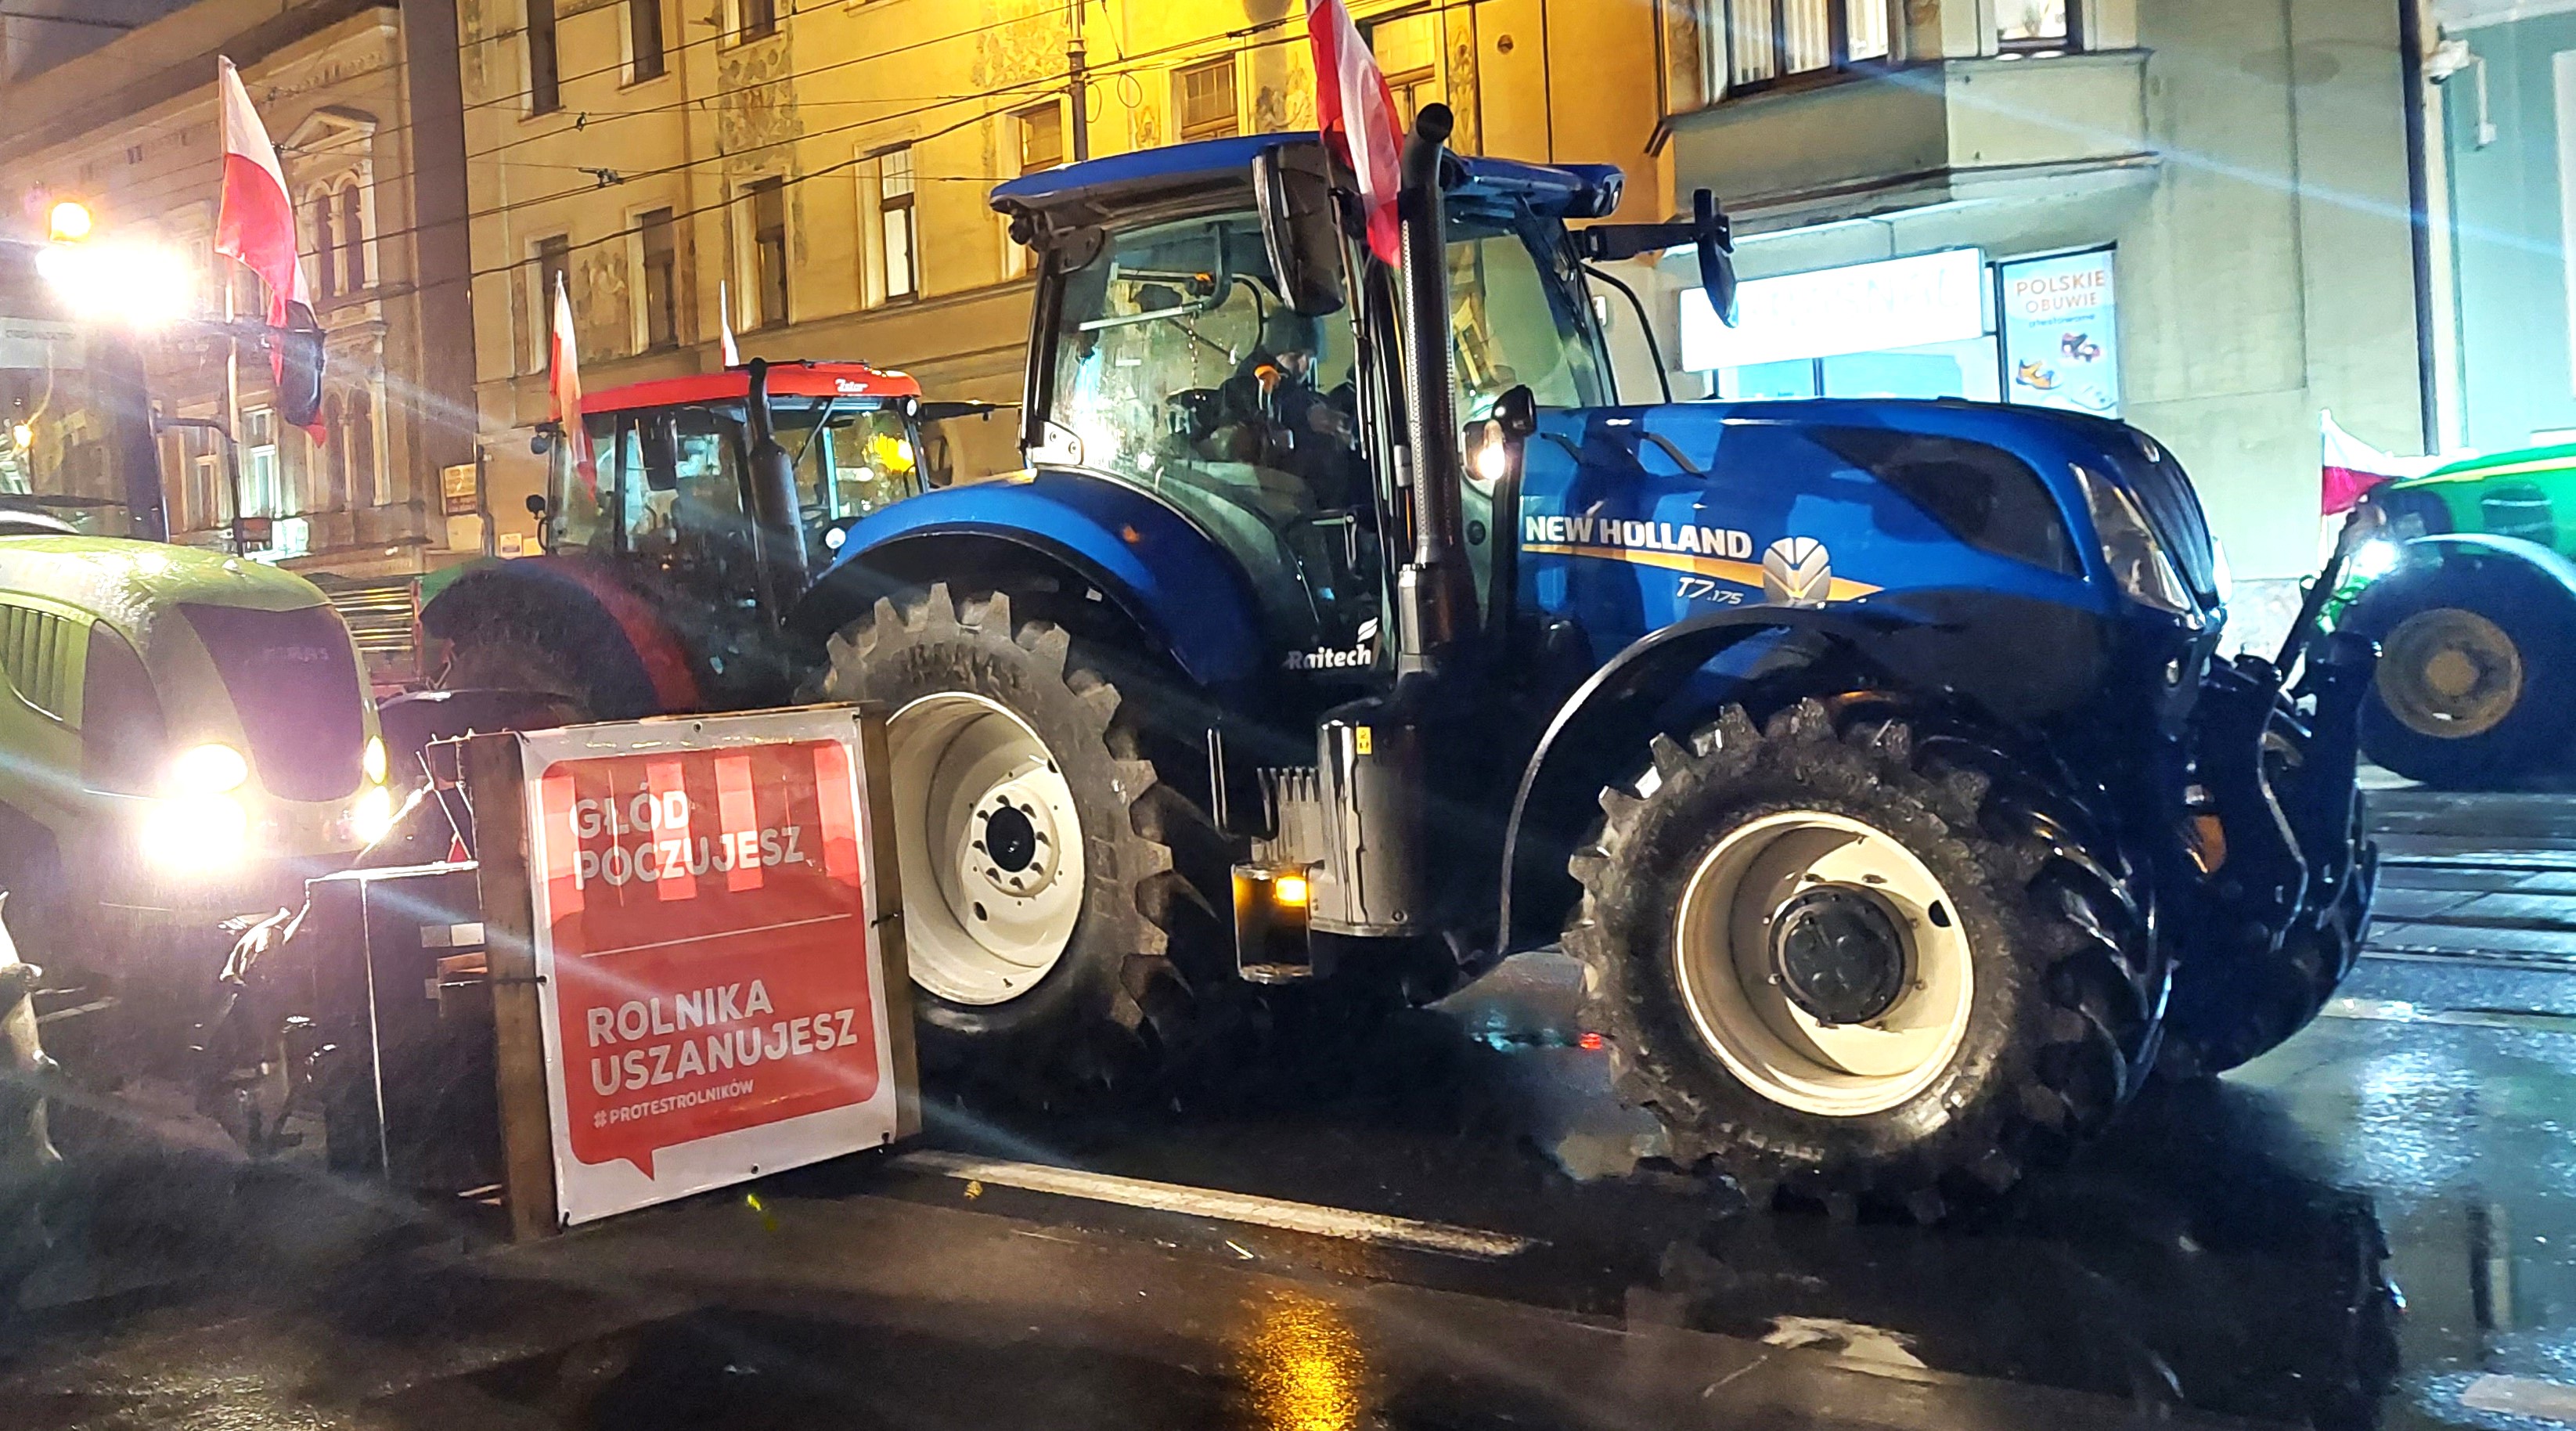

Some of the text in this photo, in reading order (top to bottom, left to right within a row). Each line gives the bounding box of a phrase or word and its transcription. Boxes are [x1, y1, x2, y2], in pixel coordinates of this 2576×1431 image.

[2016, 270, 2105, 296] POLSKIE
[2026, 292, 2098, 313] OBUWIE
[1526, 516, 1753, 559] NEW HOLLAND
[1284, 643, 1371, 670] Raitech
[570, 781, 690, 838] GŁÓD
[573, 826, 805, 890] POCZUJESZ
[588, 979, 774, 1047] ROLNIKA
[591, 1009, 858, 1096] USZANUJESZ
[593, 1078, 755, 1128] #PROTESTROLNIKÓW
